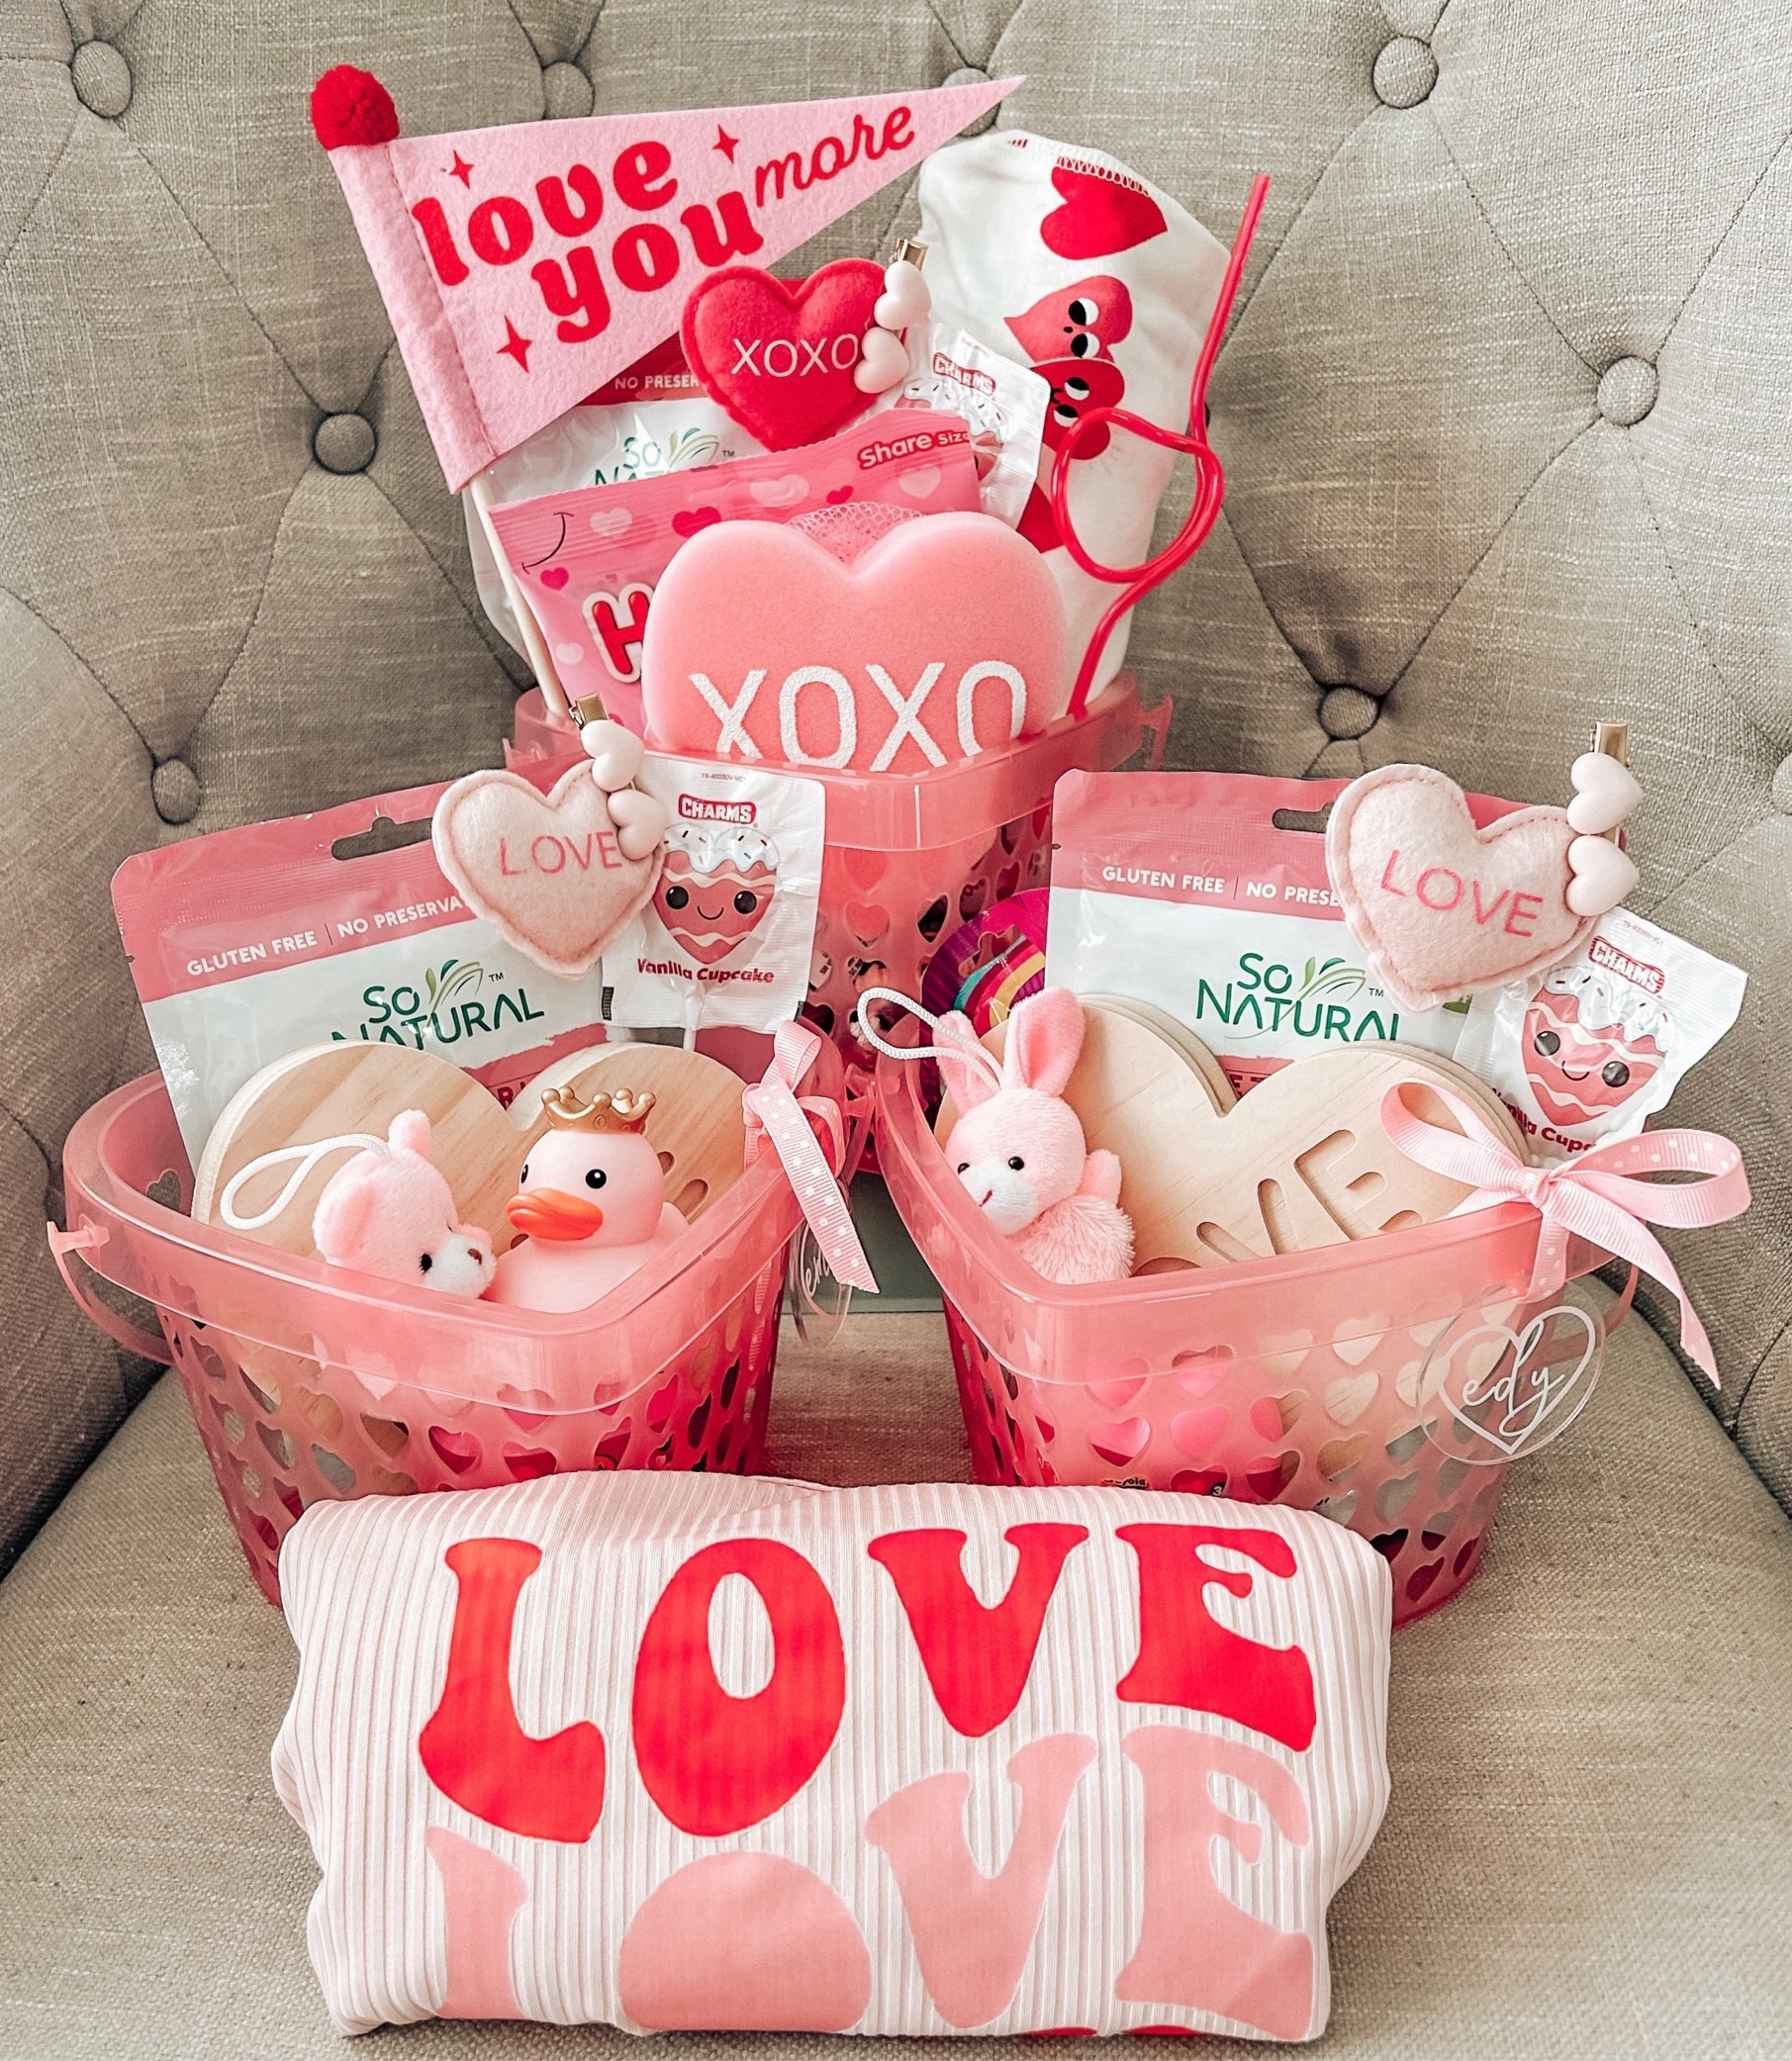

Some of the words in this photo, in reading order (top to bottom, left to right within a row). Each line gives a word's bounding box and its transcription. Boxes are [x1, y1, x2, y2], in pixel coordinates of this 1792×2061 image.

[413, 141, 678, 286] love
[531, 192, 763, 343] you
[755, 106, 914, 208] more
[730, 333, 858, 377] XOXO
[935, 356, 994, 396] CHARMS
[614, 377, 638, 390] NO
[861, 434, 932, 468] Share
[689, 660, 1026, 771] XOXO
[682, 796, 752, 823] CHARMS
[500, 830, 623, 876] LOVE
[1101, 866, 1176, 889] GLUTEN
[1181, 875, 1225, 894] FREE
[1246, 882, 1277, 899] NO
[1380, 849, 1543, 938] LOVE
[187, 943, 267, 977] GLUTEN
[271, 931, 318, 955] FREE
[336, 918, 369, 938] NO
[1592, 940, 1660, 993] CHARMS
[637, 959, 693, 980] Vanilla
[697, 969, 775, 992] Cupcake
[1462, 1320, 1566, 1438] edy
[419, 1523, 1317, 1844] LOVE
